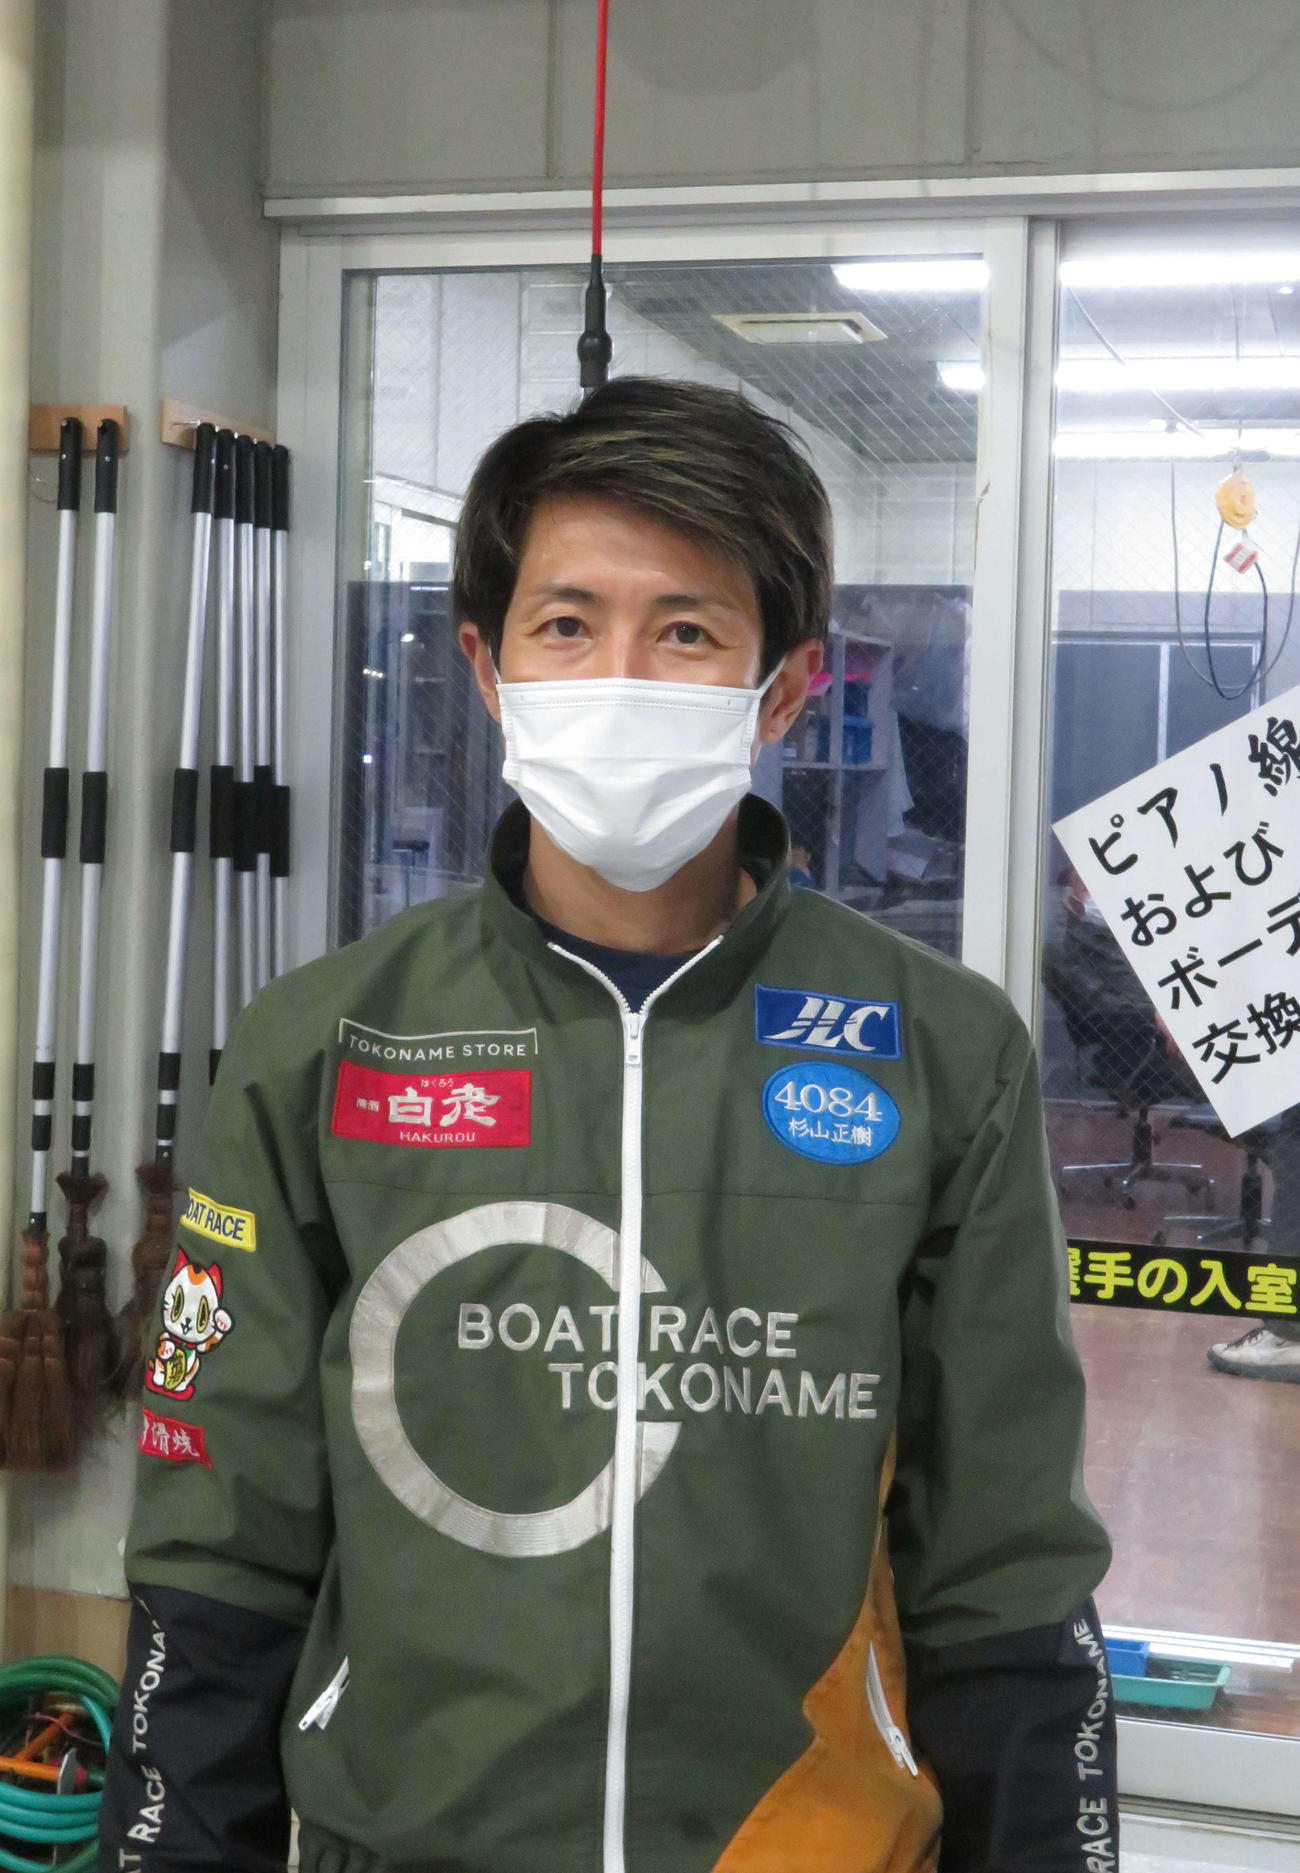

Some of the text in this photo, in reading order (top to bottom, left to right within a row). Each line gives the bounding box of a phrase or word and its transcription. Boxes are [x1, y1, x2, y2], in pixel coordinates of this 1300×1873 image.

[1121, 822, 1284, 947] および
[350, 1034, 526, 1061] TOKONAME STORE
[763, 996, 890, 1051] JLC
[1193, 992, 1300, 1084] 交換
[421, 1078, 454, 1087] はくろう
[774, 1080, 883, 1122] 4084
[400, 1131, 476, 1143] HAKUROU
[788, 1117, 872, 1147] 杉山正樹
[205, 1208, 246, 1242] RACE
[458, 1303, 799, 1358] BOAT RACE
[548, 1362, 881, 1420] TOKONAME
[1074, 1618, 1108, 1781] TOKONAME
[127, 1765, 166, 1843] RACE
